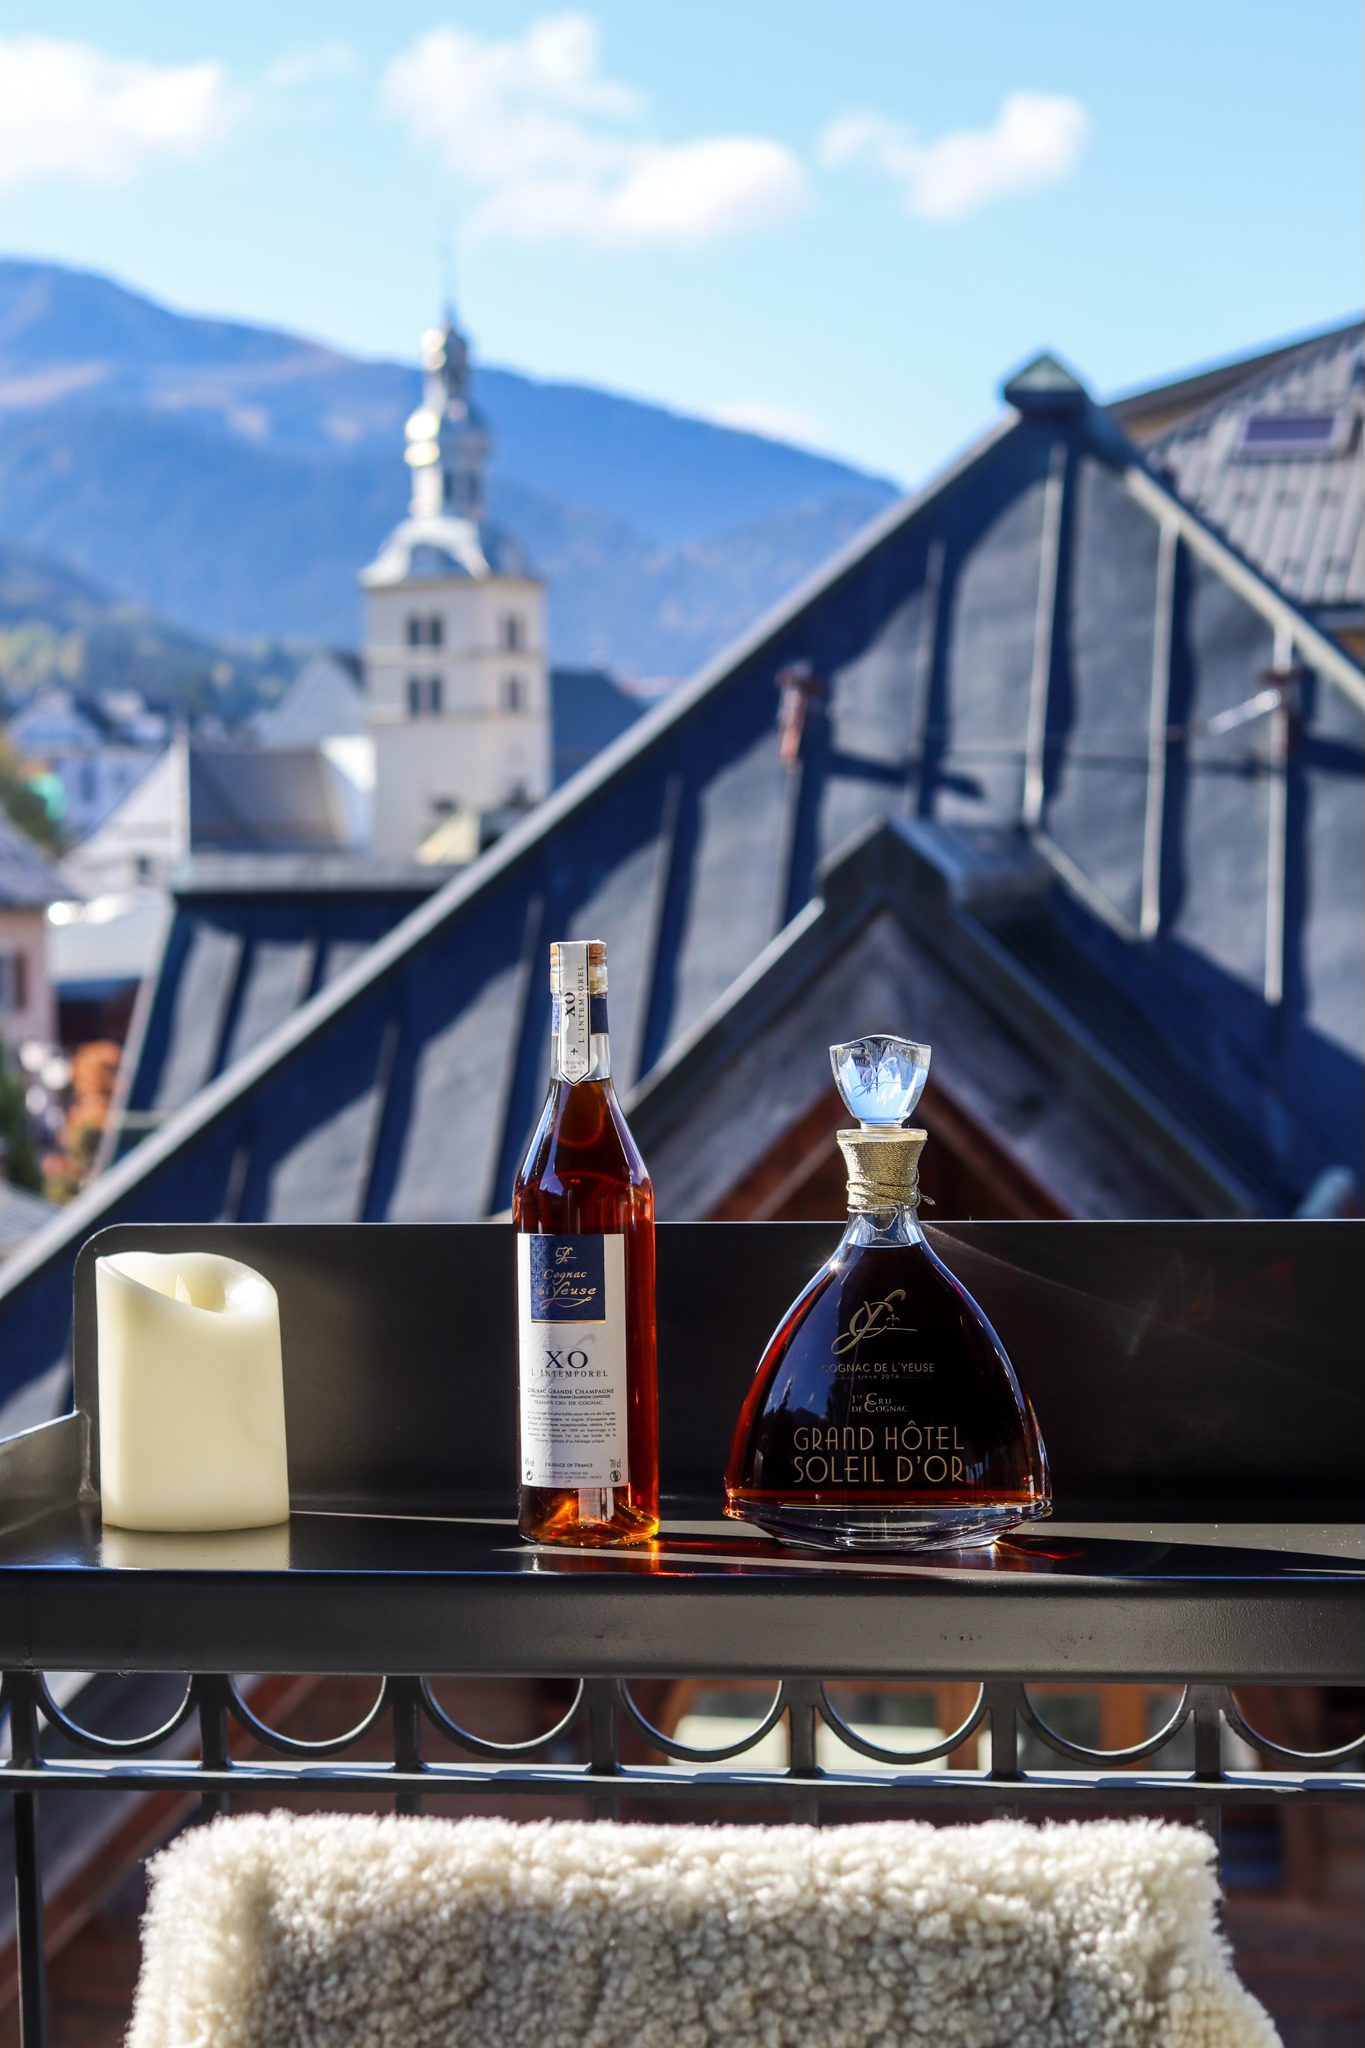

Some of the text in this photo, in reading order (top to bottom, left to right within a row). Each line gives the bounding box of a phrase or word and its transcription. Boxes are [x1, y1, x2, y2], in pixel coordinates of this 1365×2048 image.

[564, 992, 576, 1017] XO
[543, 1269, 587, 1285] Cognac
[545, 1350, 589, 1369] XO
[821, 1362, 935, 1373] COGNAC DE L'YEUSE
[527, 1387, 547, 1395] COGNAC
[866, 1392, 892, 1405] CRU
[864, 1401, 909, 1413] COGNAC
[793, 1420, 965, 1450] GRAND HÔTEL
[793, 1456, 965, 1483] SOLEIL D'OR
